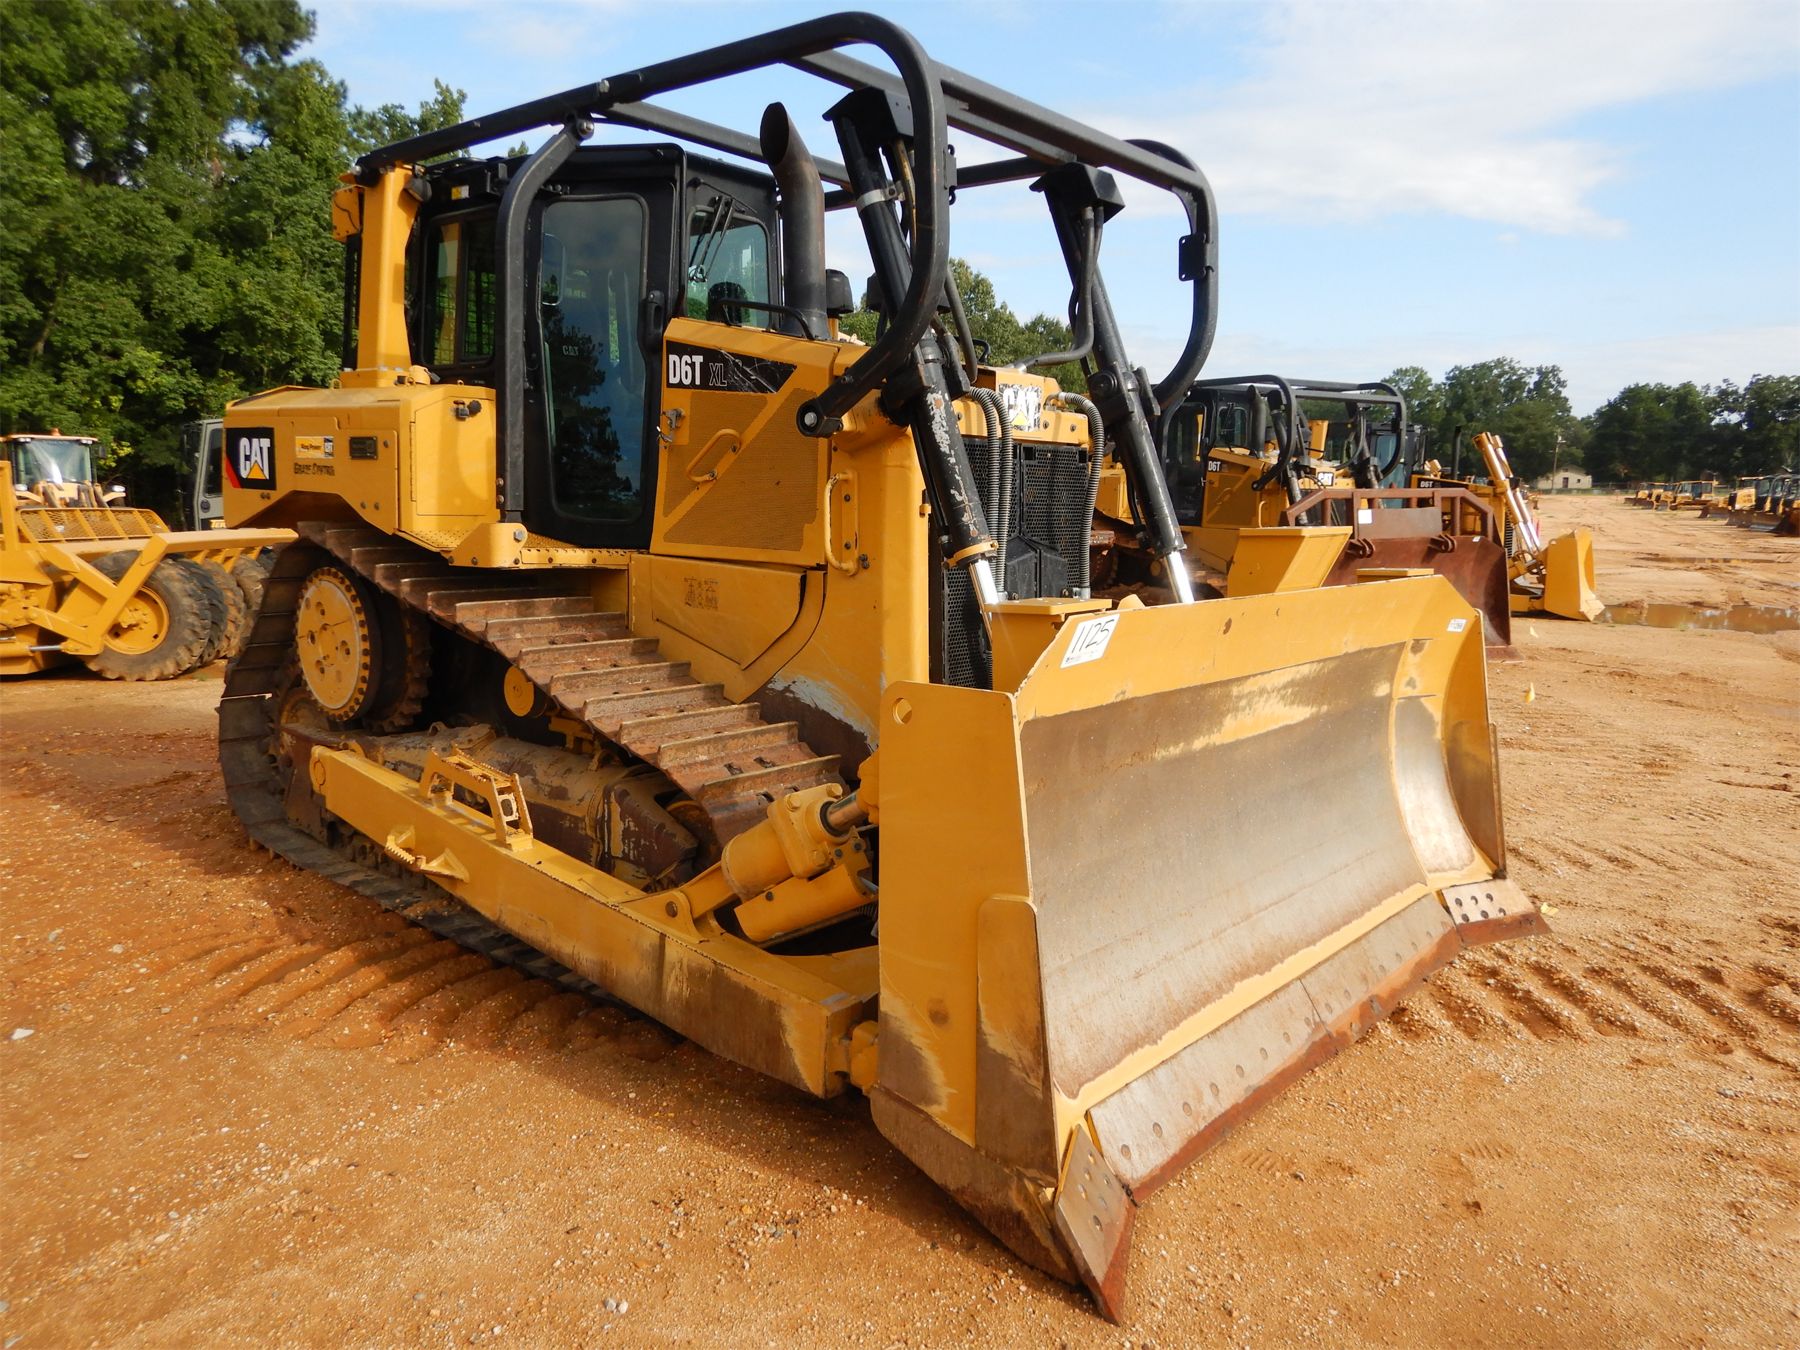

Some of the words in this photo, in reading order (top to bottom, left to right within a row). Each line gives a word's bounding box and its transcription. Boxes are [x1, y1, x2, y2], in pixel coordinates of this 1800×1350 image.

[562, 345, 579, 356] CAT
[668, 354, 704, 386] D6T
[709, 362, 728, 387] XL
[1002, 387, 1038, 433] CAT
[239, 437, 271, 480] CAT
[1208, 460, 1221, 472] D6T
[1072, 619, 1115, 654] 1125
